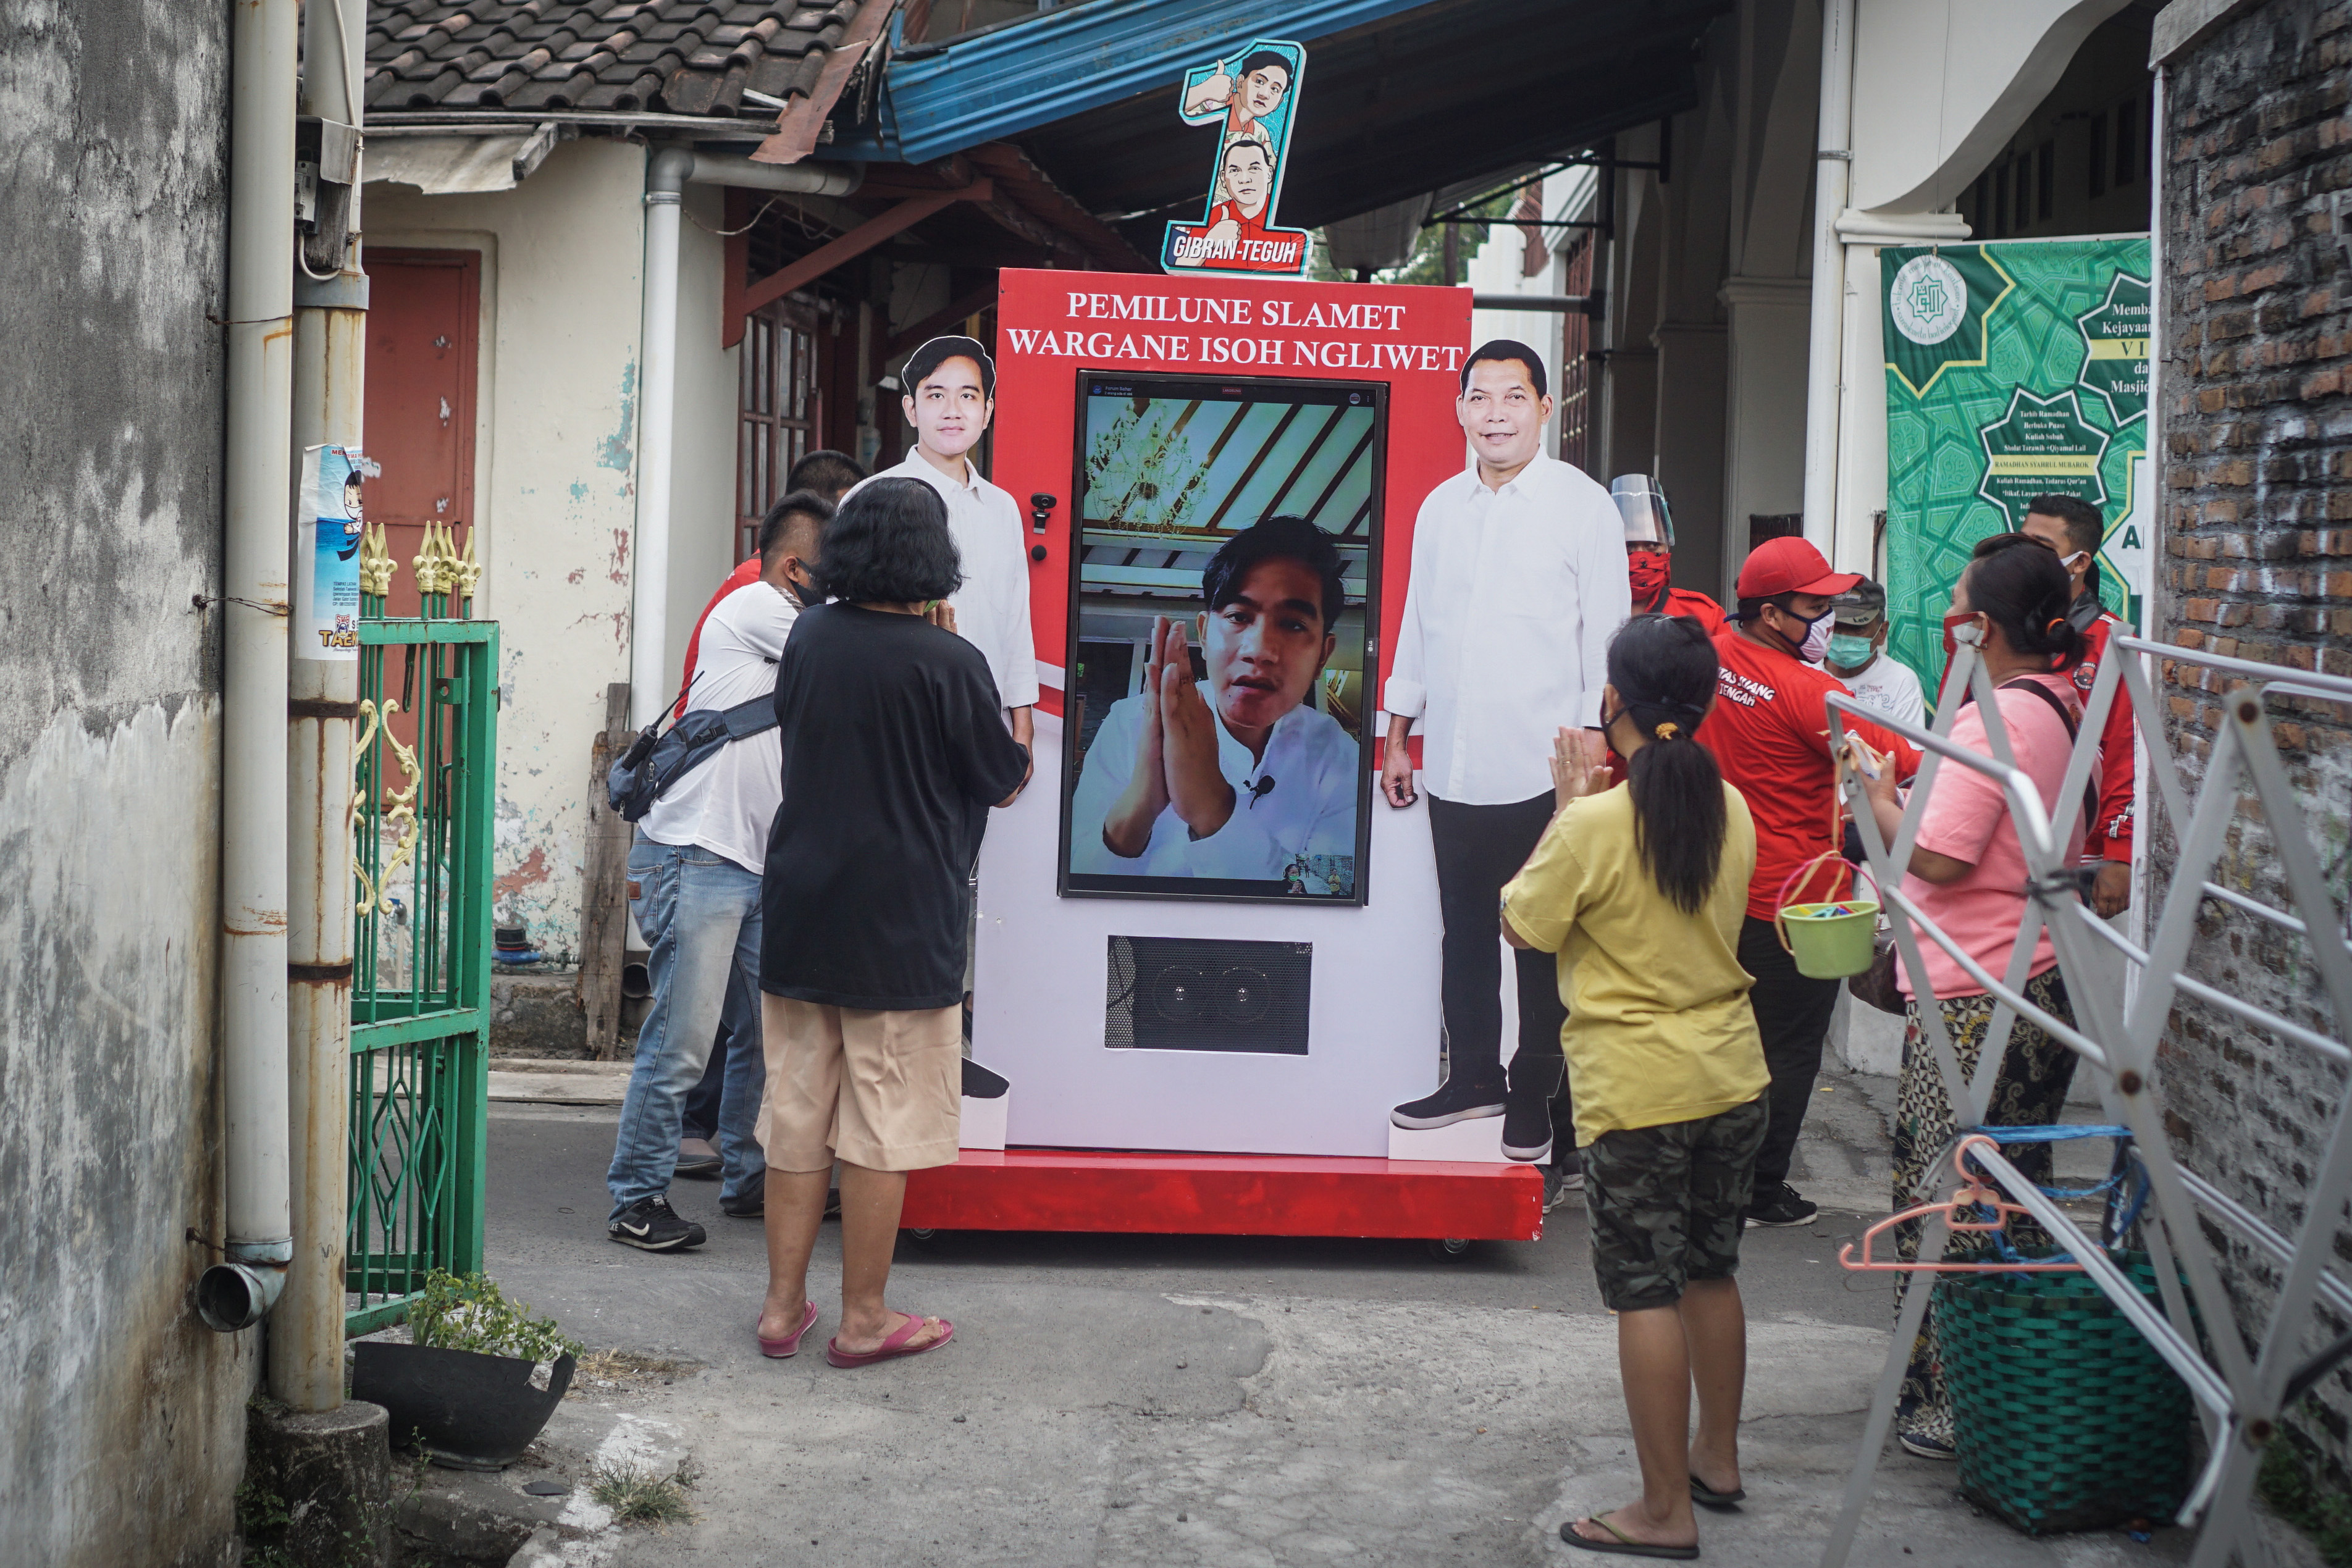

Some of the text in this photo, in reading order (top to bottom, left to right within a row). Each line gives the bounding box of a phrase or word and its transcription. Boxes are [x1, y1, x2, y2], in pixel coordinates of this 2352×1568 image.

[1173, 235, 1297, 263] GIBRAN-TEGUH
[1066, 292, 1406, 330] PEMILUNE SLAMET
[1006, 329, 1463, 371] WARGANE ISOH NGLIWET
[1719, 683, 1755, 706] TENGAH
[1737, 676, 1775, 700] JUANG
